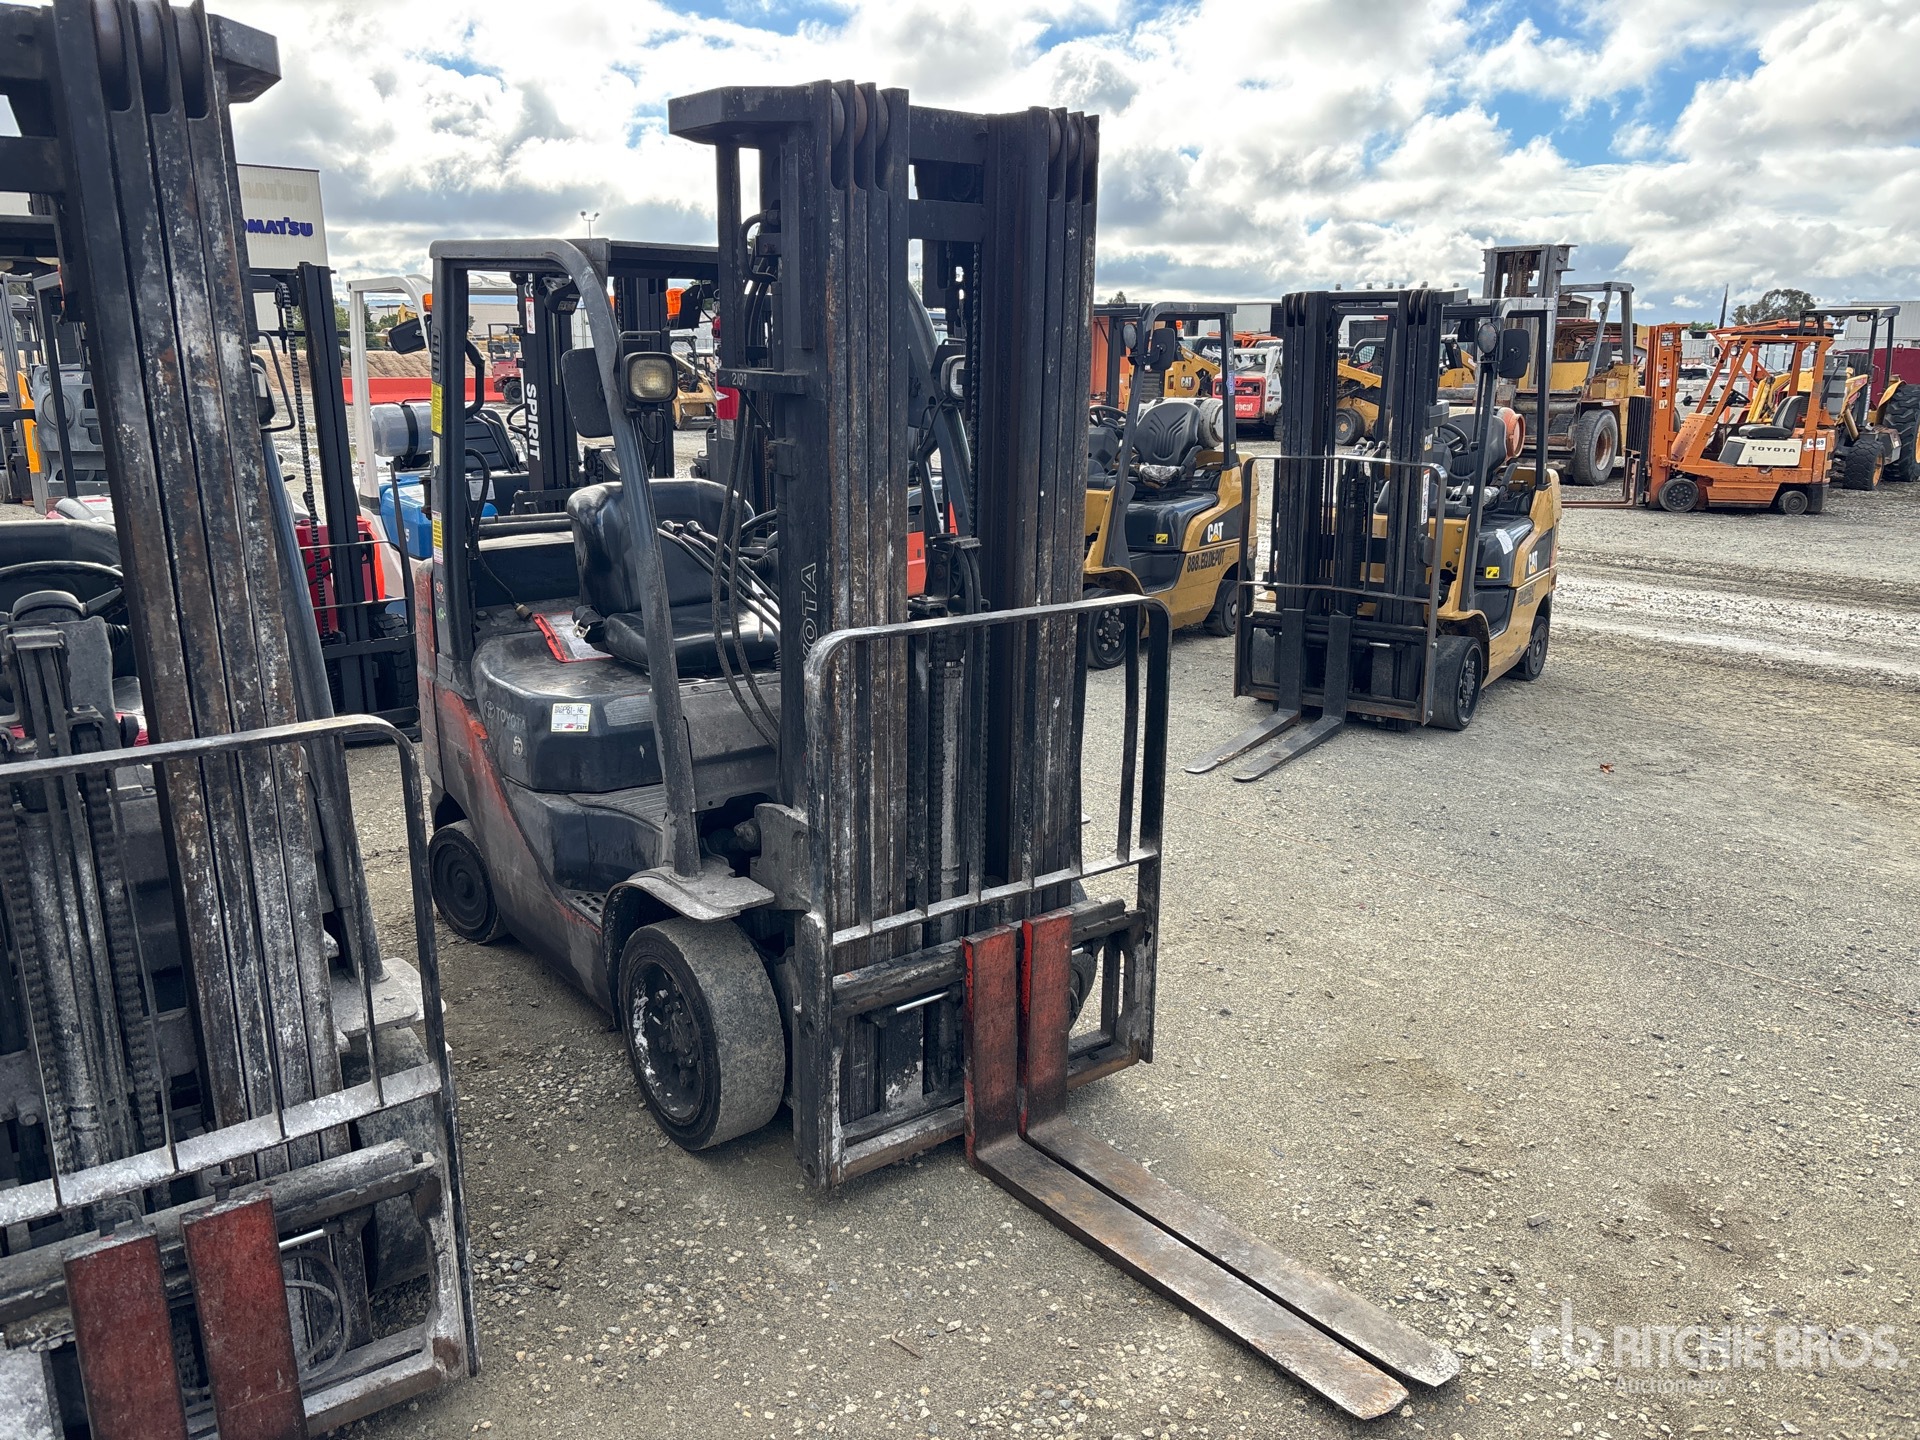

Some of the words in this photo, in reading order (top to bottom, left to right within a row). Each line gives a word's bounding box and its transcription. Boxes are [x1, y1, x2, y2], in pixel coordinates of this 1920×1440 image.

[244, 217, 313, 237] MATSU
[1181, 376, 1193, 388] CAT
[1235, 403, 1254, 412] obcat
[526, 383, 540, 461] SPIRIT
[1750, 445, 1796, 453] TOYOTA
[1207, 521, 1224, 543] CAT
[1528, 550, 1538, 575] CAT
[496, 706, 526, 730] TOYOTA
